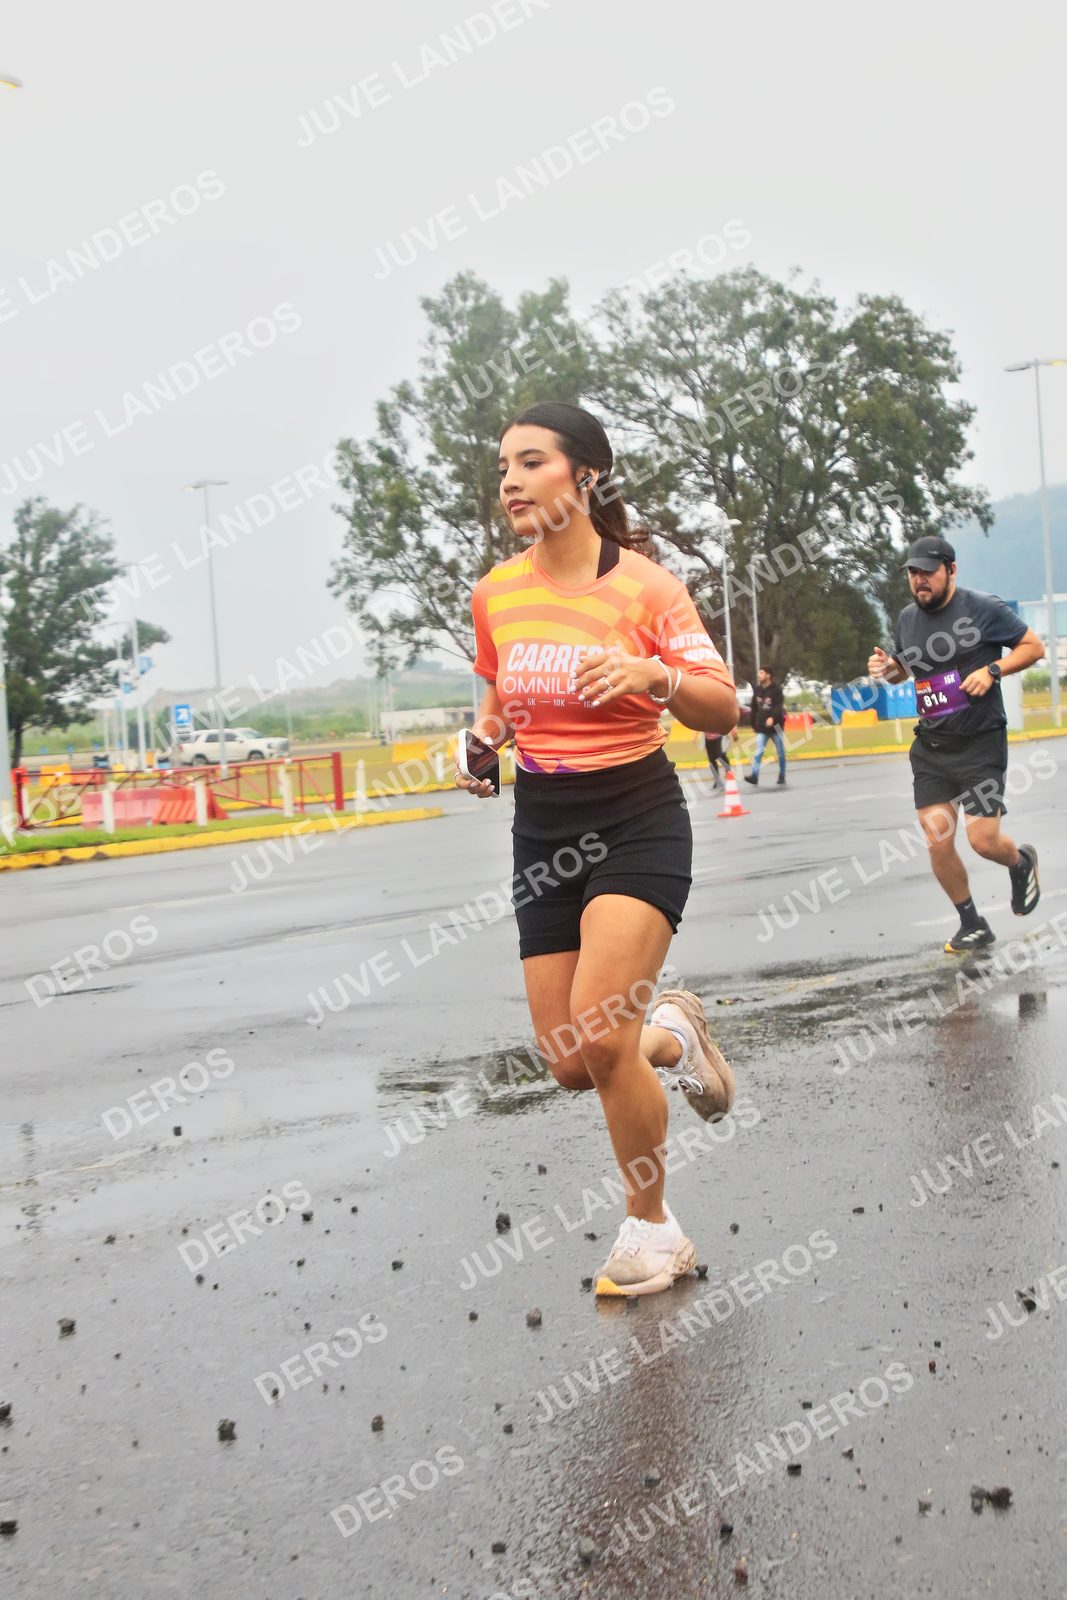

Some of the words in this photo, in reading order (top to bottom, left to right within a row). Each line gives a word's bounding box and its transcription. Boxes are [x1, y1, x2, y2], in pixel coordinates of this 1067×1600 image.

[506, 642, 619, 678] CARRE
[502, 675, 591, 695] OMNILI
[923, 692, 948, 707] 814
